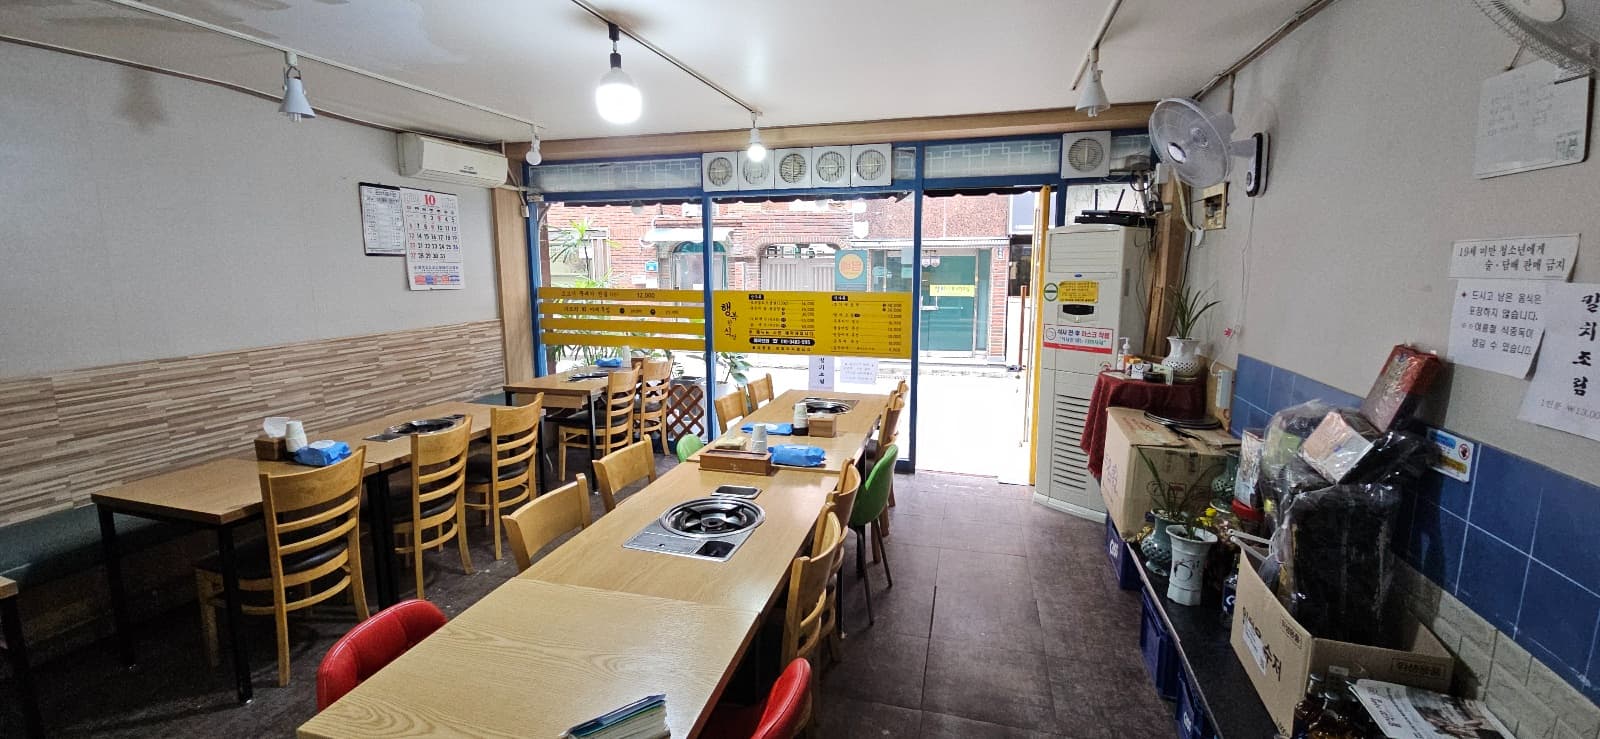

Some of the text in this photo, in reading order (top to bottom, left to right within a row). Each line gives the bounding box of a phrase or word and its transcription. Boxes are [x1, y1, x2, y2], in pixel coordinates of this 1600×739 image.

[424, 194, 436, 206] 10
[1460, 243, 1545, 257] 19세 미만 청소년에게
[1523, 259, 1541, 271] 판매
[1546, 258, 1565, 271] 금지
[1472, 290, 1542, 304] 드시고 남은 음식은
[1470, 306, 1538, 320] 포장하지 않습니다.
[1474, 322, 1534, 339] 여름철 식중독이
[1472, 338, 1485, 349] 생길
[1490, 340, 1497, 350] 수
[1540, 400, 1562, 409] 1인분
[1263, 644, 1282, 682] 수저
